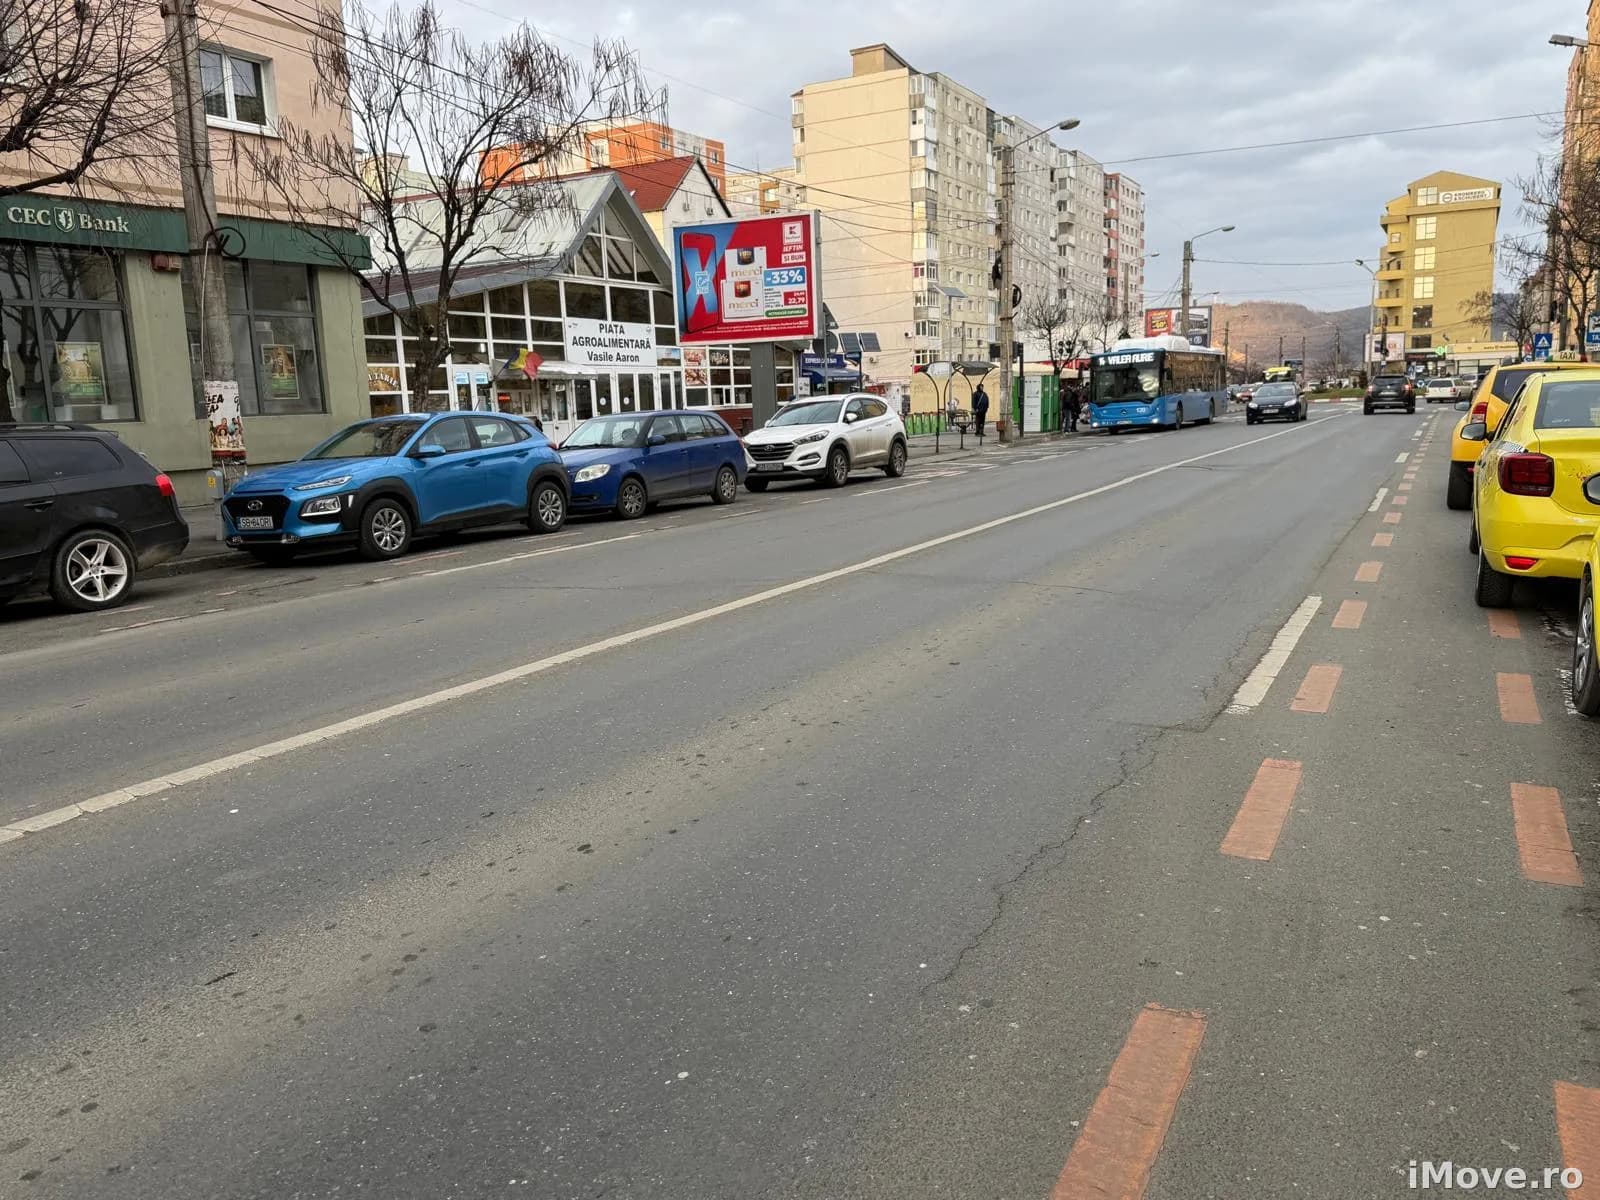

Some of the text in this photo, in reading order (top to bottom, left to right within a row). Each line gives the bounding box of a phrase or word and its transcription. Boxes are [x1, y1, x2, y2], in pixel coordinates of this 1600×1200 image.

[7, 207, 130, 233] CEC Bank
[731, 266, 763, 277] merci
[766, 269, 803, 284] -33%
[728, 298, 759, 310] merci
[572, 335, 651, 350] AGROALIMENTARĂ
[587, 351, 640, 362] Vasile Aaron
[1559, 352, 1576, 360] TAXI
